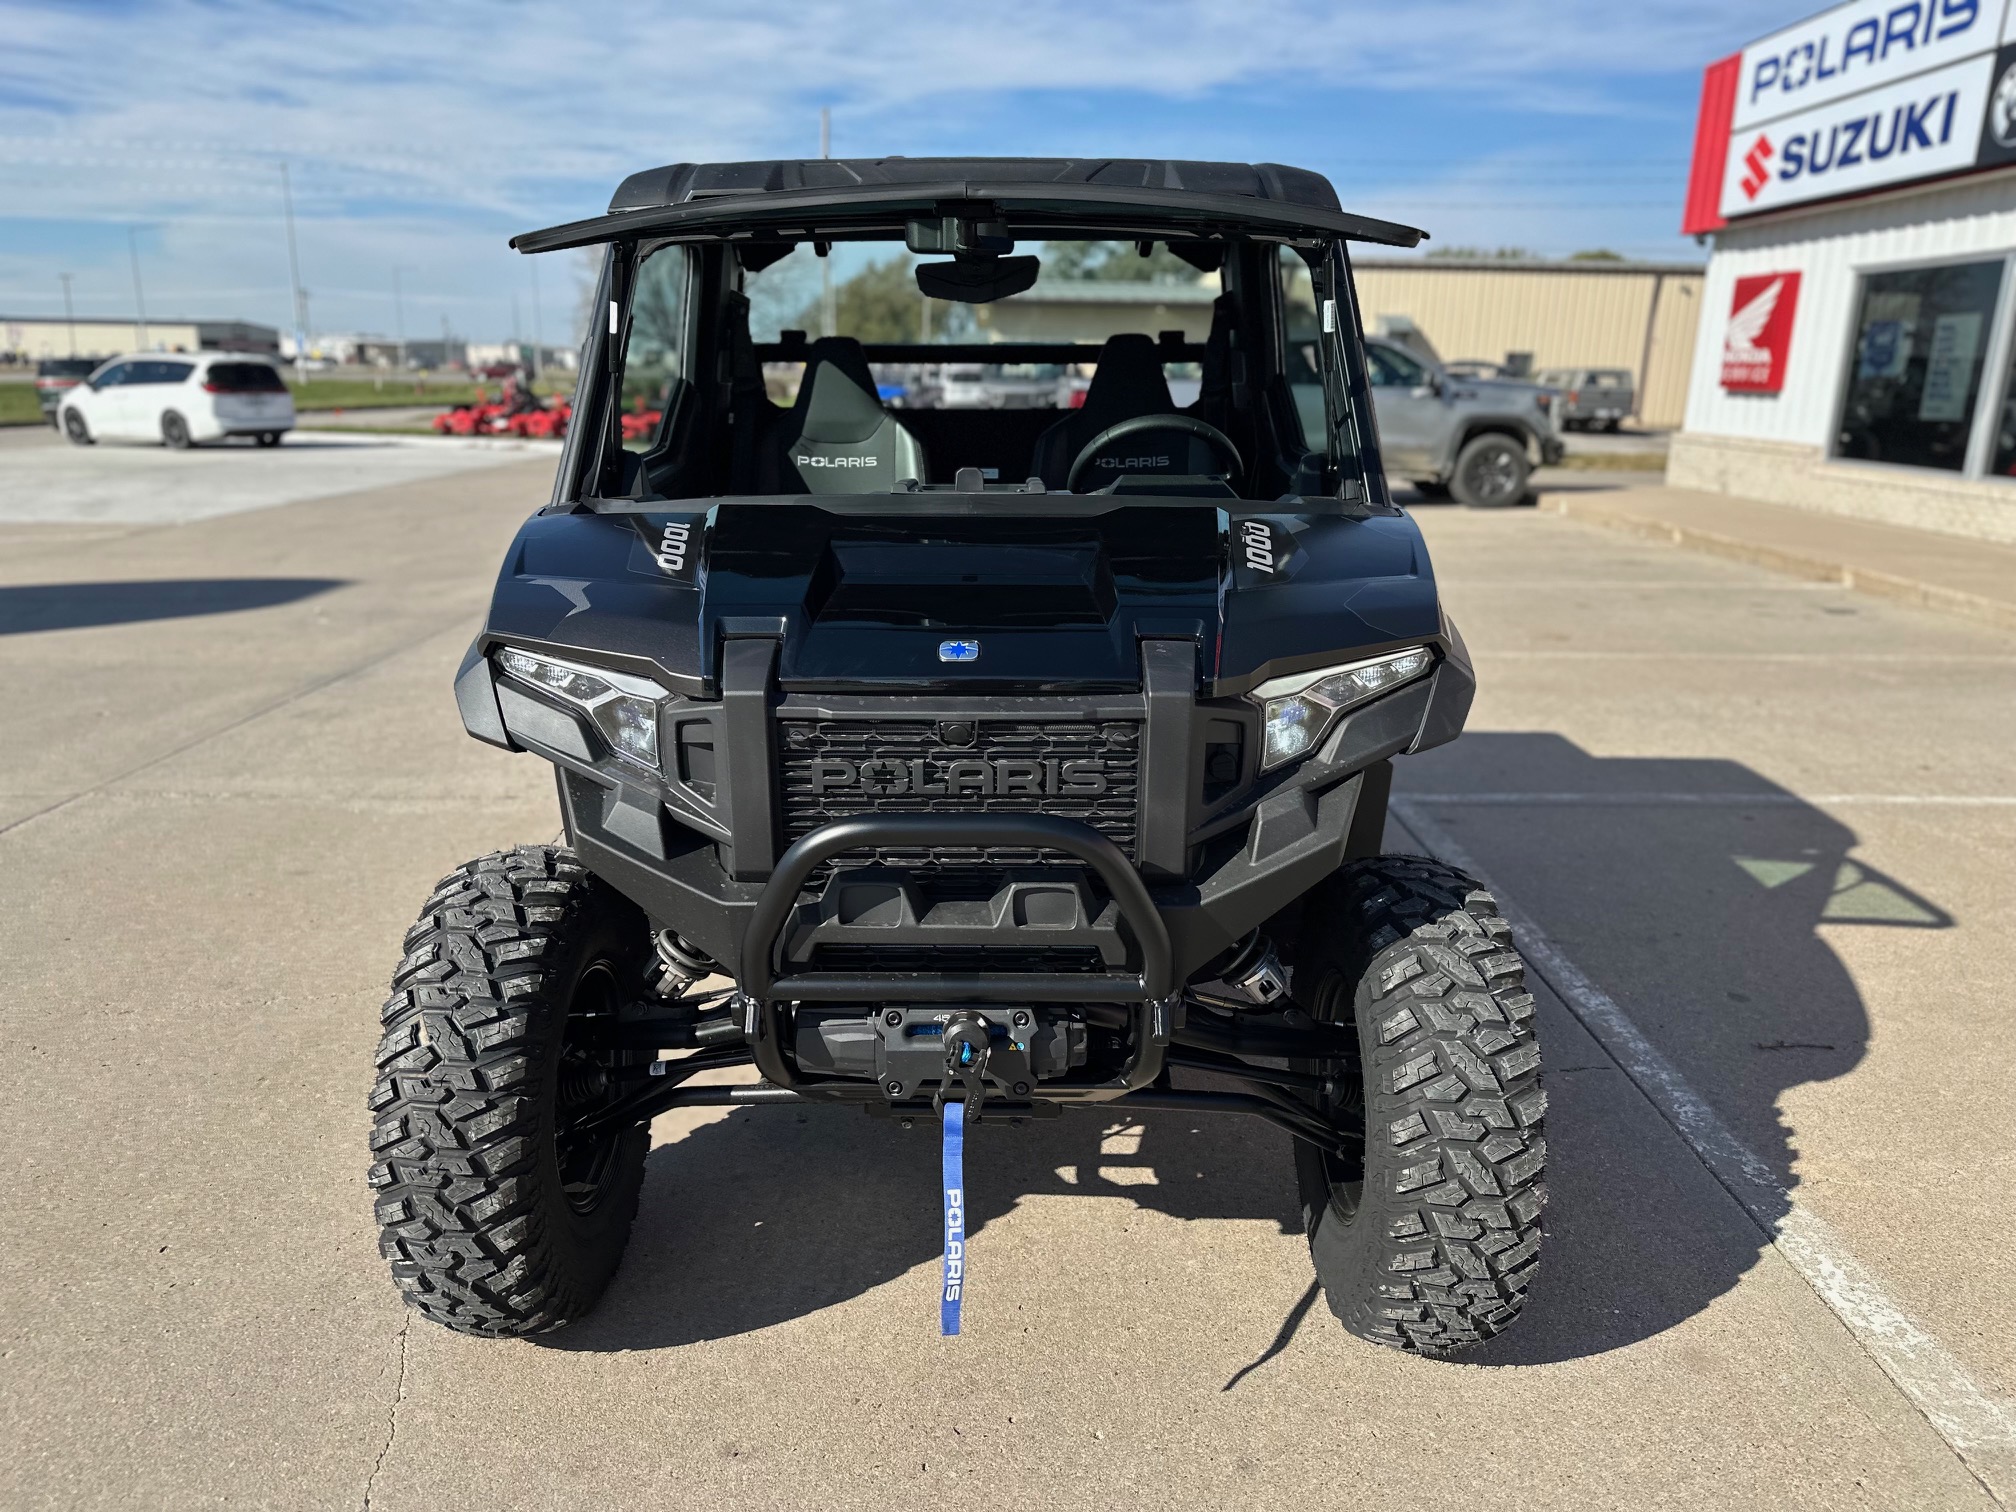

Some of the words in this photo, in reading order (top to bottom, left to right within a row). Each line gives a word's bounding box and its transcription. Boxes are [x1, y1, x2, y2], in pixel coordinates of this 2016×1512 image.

[1751, 0, 1978, 105] POLARIS
[1779, 89, 1959, 181] SUZUKI
[797, 455, 877, 468] POLARIS
[657, 522, 691, 571] 1000
[1242, 521, 1274, 574] 1000
[811, 758, 1107, 796] POLARIS
[946, 1188, 962, 1302] POLARIS
